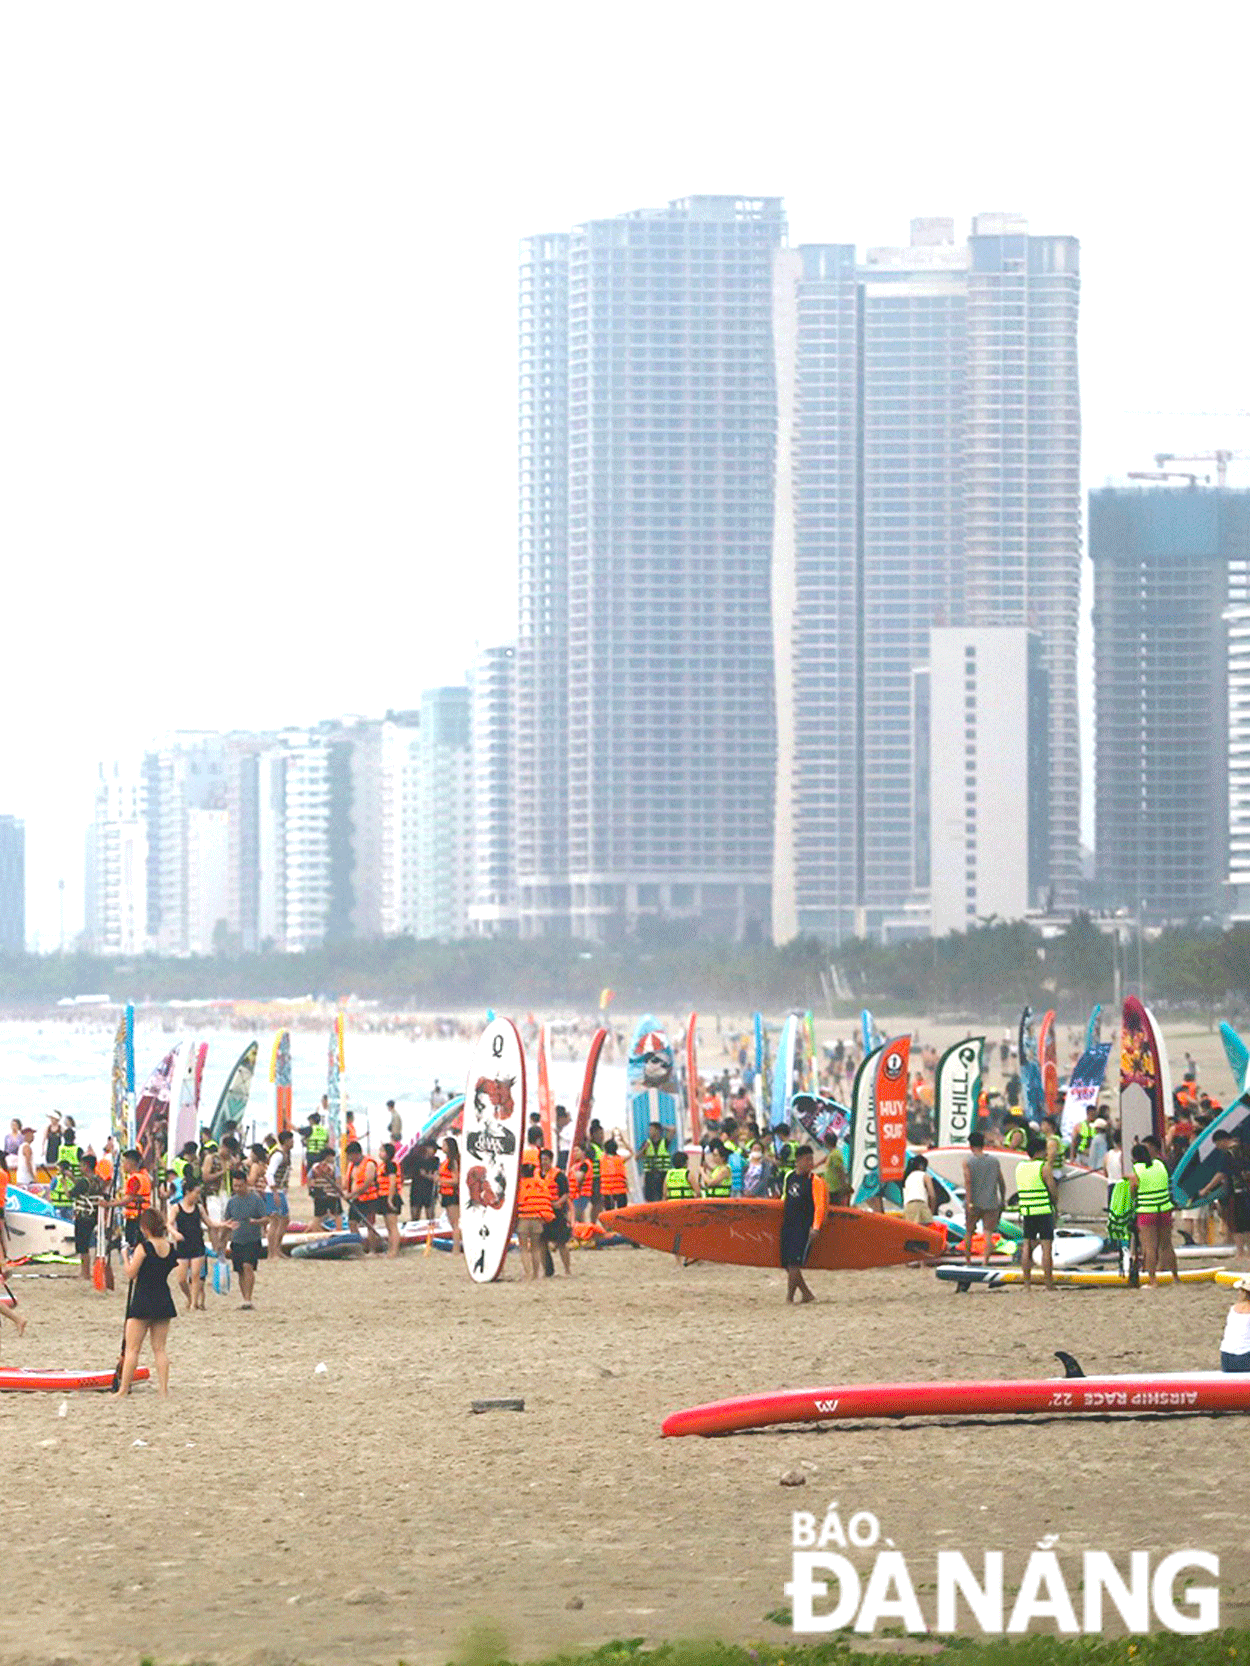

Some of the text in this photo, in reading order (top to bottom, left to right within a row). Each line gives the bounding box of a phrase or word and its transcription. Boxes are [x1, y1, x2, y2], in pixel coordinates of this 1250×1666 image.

[491, 1034, 504, 1058] Q
[878, 1100, 905, 1117] HUY
[950, 1072, 968, 1130] CHILL
[1083, 1391, 1128, 1406] RACE
[1131, 1391, 1198, 1406] AIRSHIP
